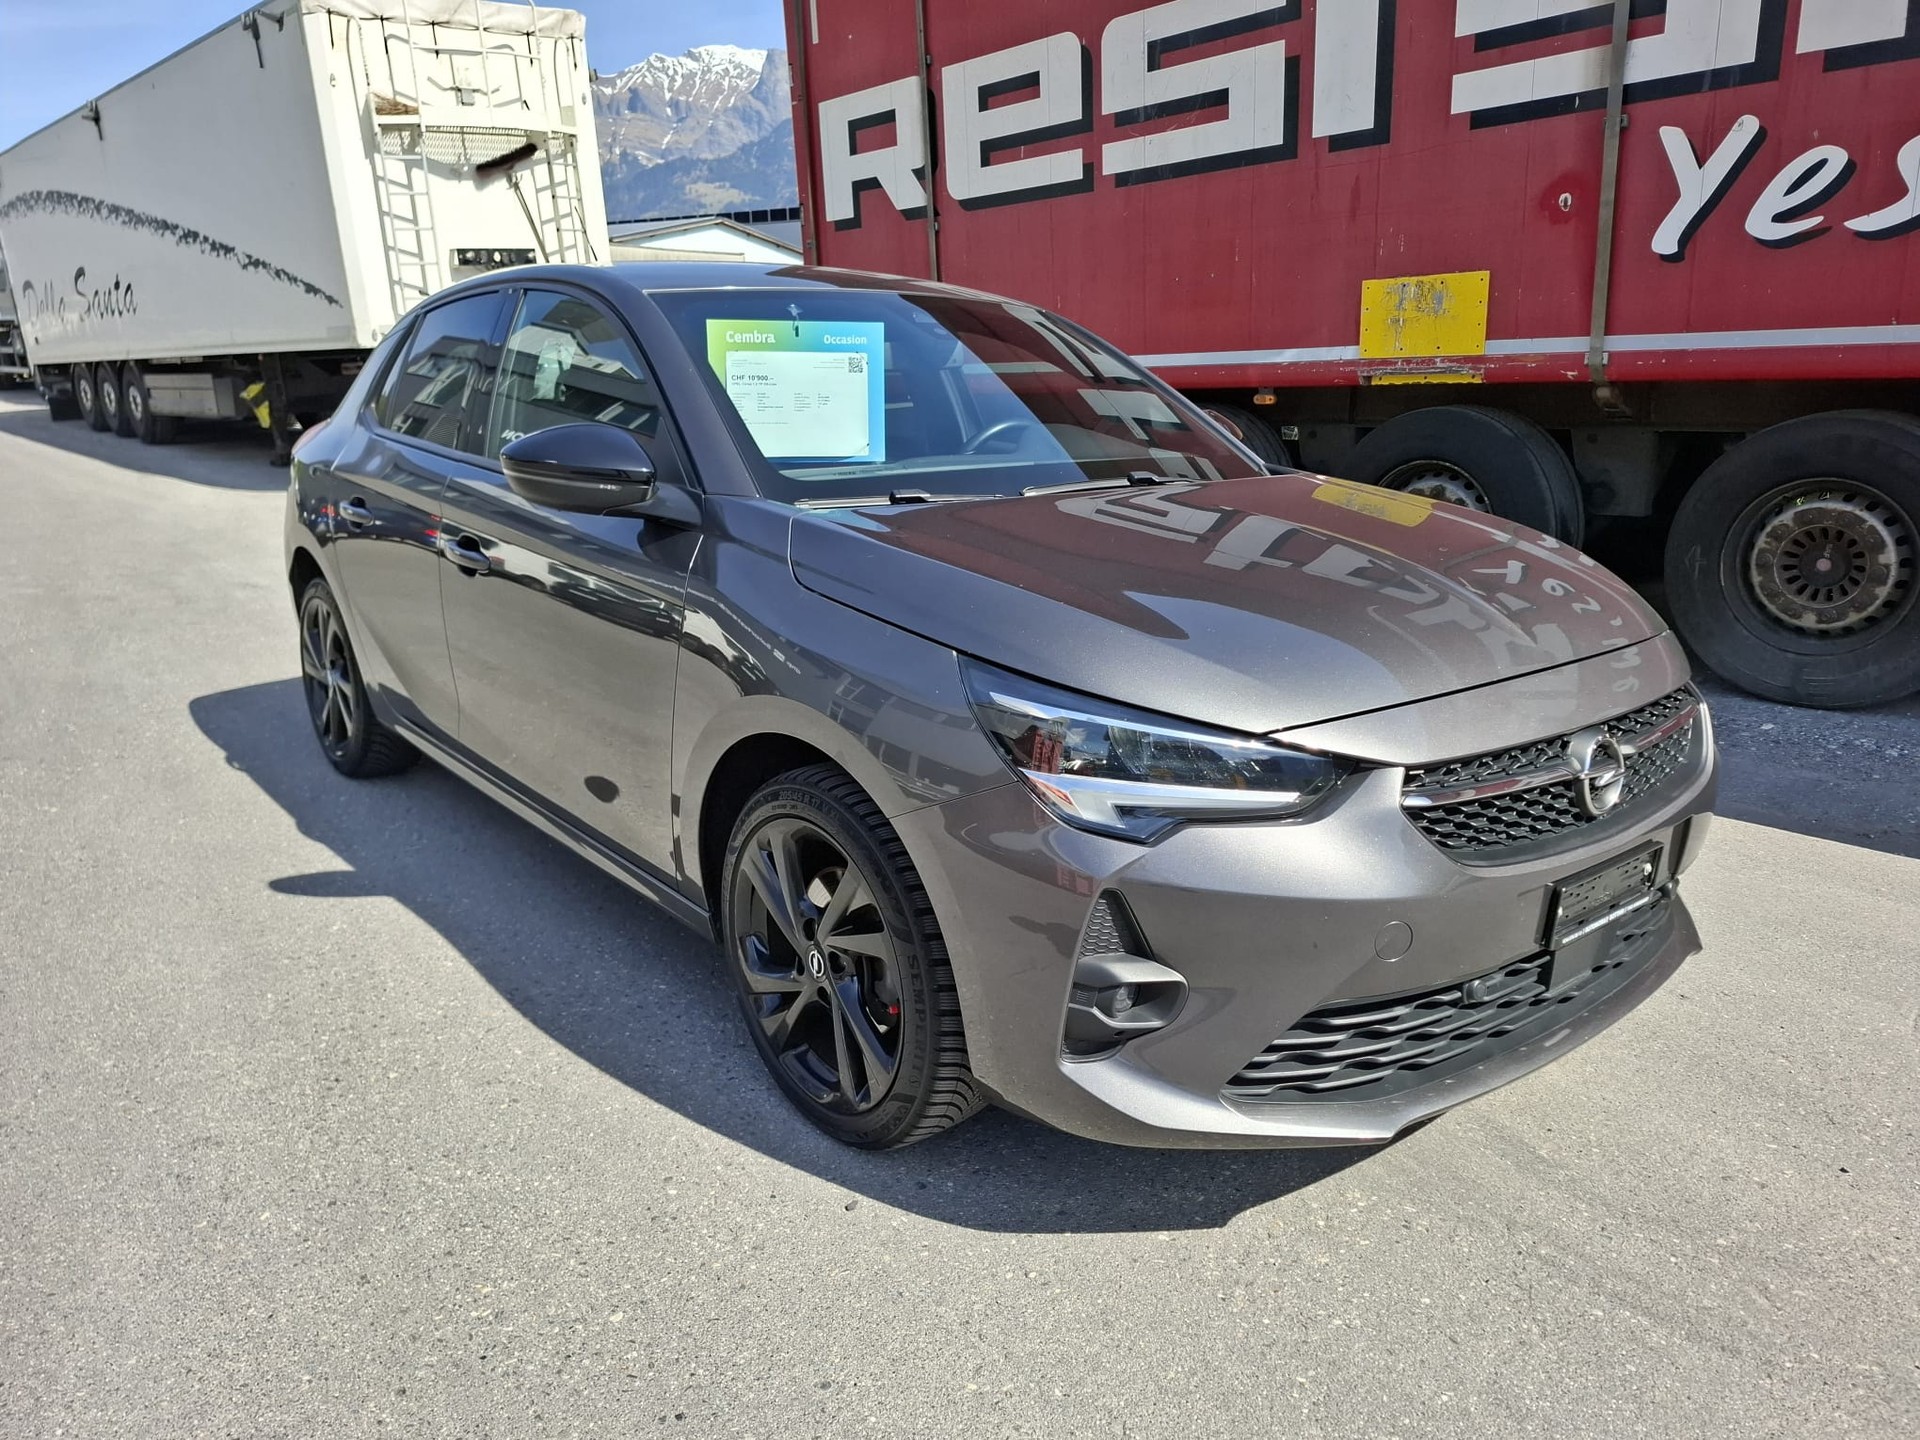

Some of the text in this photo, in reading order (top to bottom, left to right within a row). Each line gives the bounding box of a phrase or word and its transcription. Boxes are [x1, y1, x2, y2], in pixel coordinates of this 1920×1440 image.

[74, 266, 138, 322] Santa
[726, 330, 867, 345] Cembra Occasion
[907, 954, 926, 1072] SEMPERIT
